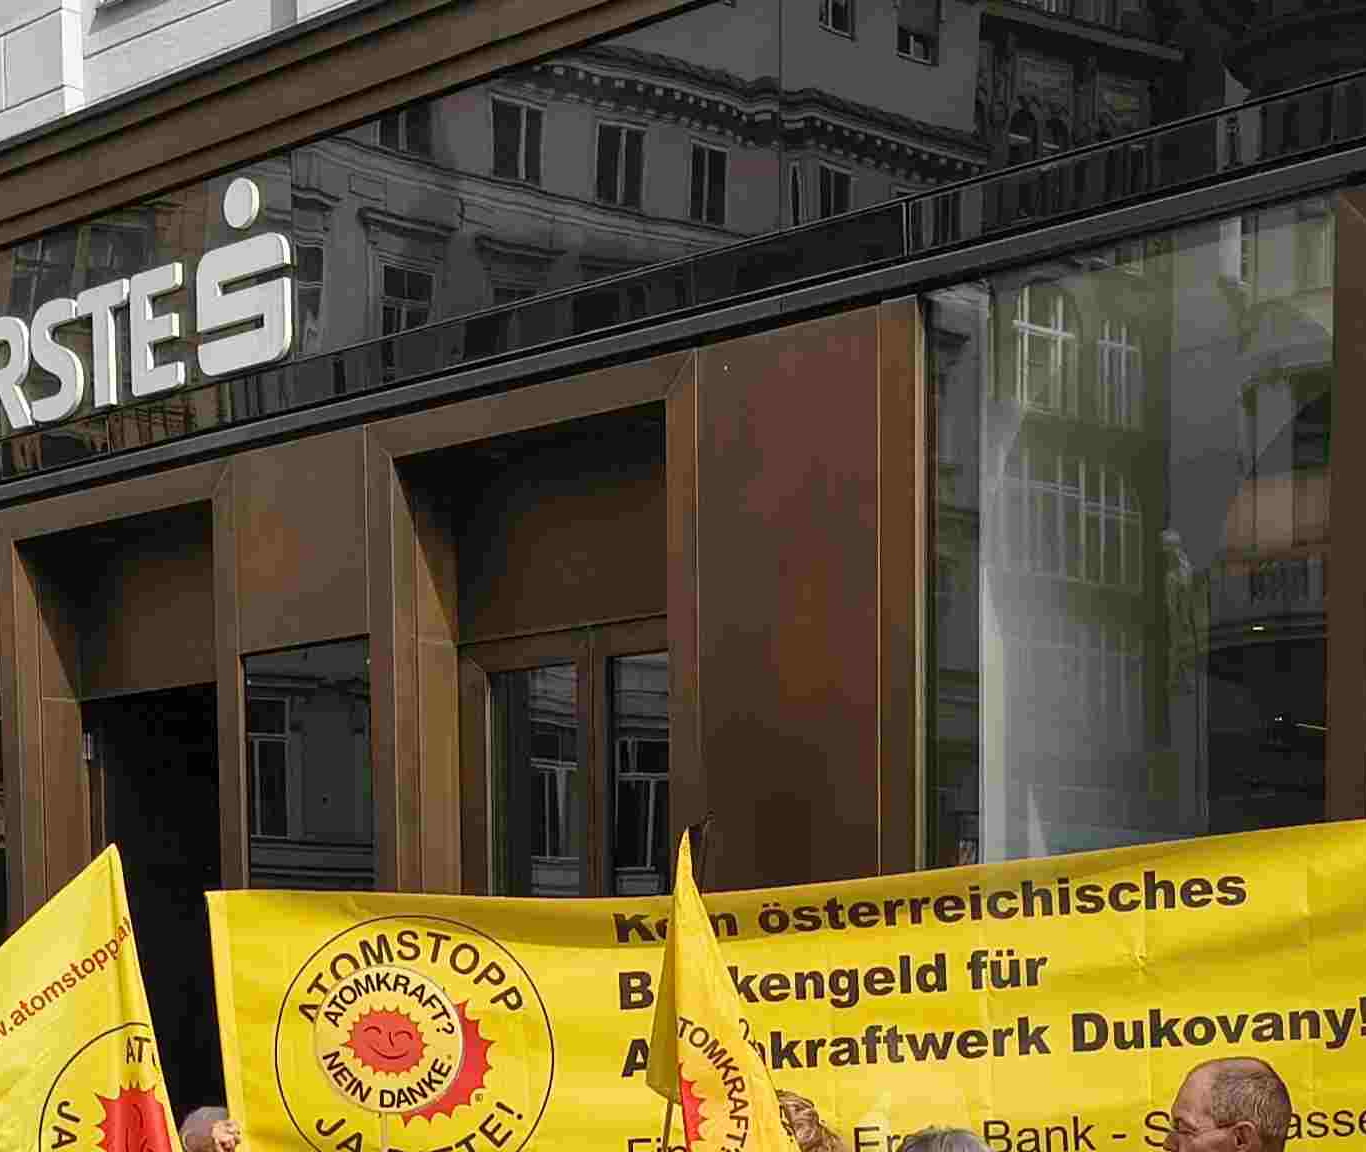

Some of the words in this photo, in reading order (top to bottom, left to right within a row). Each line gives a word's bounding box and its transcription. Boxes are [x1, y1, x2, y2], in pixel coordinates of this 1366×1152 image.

[758, 870, 1248, 934] österreichisches
[298, 930, 524, 1024] ATOMSTOPP
[327, 972, 456, 1036] ATOMKRAFT?
[618, 952, 948, 1010] Bkengeld
[966, 949, 1047, 990] für
[322, 1050, 372, 1104] NEIN
[379, 1056, 452, 1109] DANKE
[51, 1100, 80, 1150] JA
